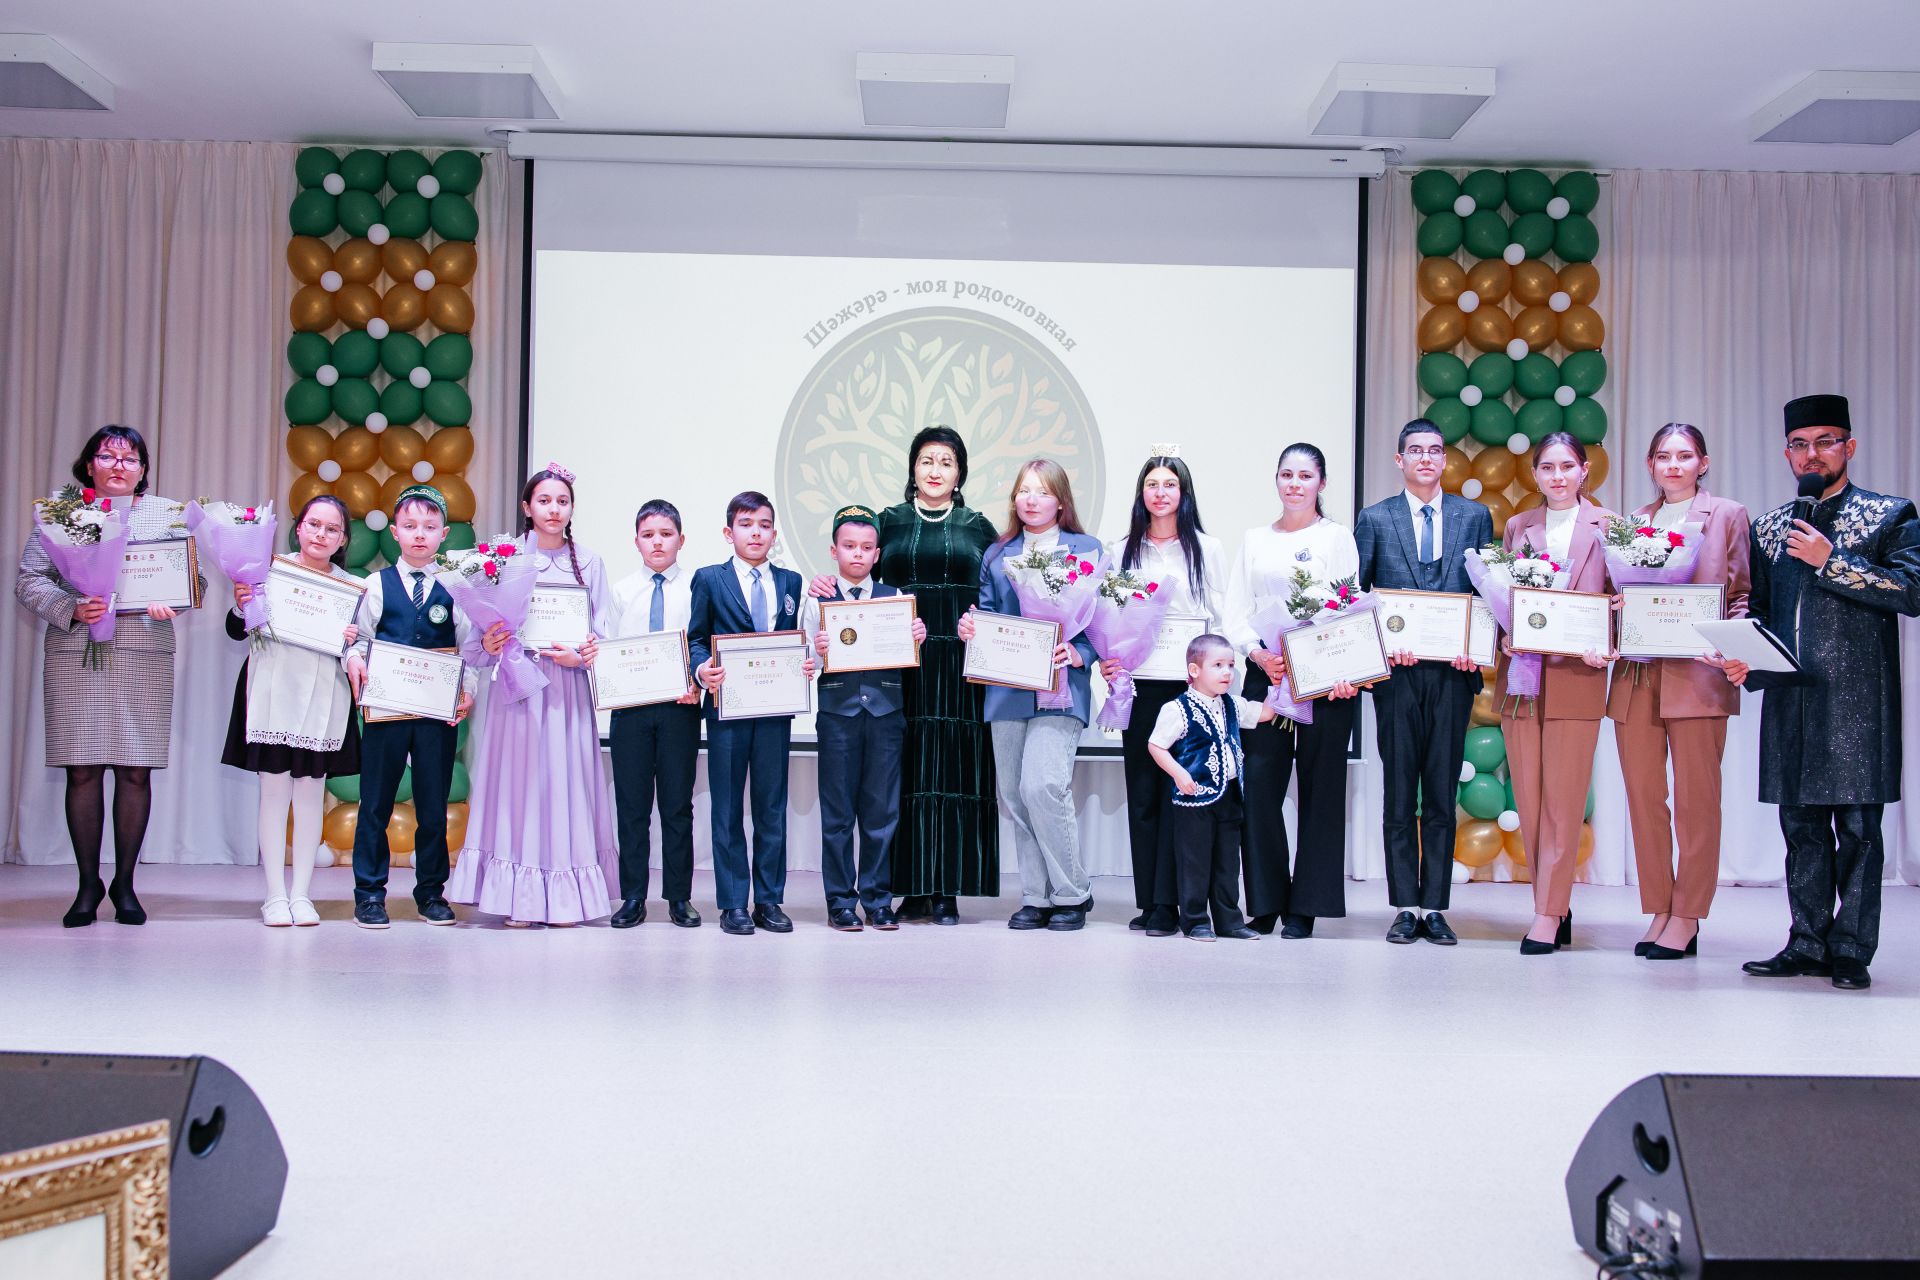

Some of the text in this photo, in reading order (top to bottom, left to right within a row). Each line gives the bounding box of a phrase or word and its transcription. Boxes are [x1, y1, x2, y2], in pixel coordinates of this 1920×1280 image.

[906, 280, 947, 296] моя
[953, 280, 1077, 352] родословная
[121, 566, 164, 574] СЕРТИФИКАТ
[284, 598, 328, 615] СЕРТИФИКАТ
[392, 669, 434, 681] СЕРТИФИКАТ
